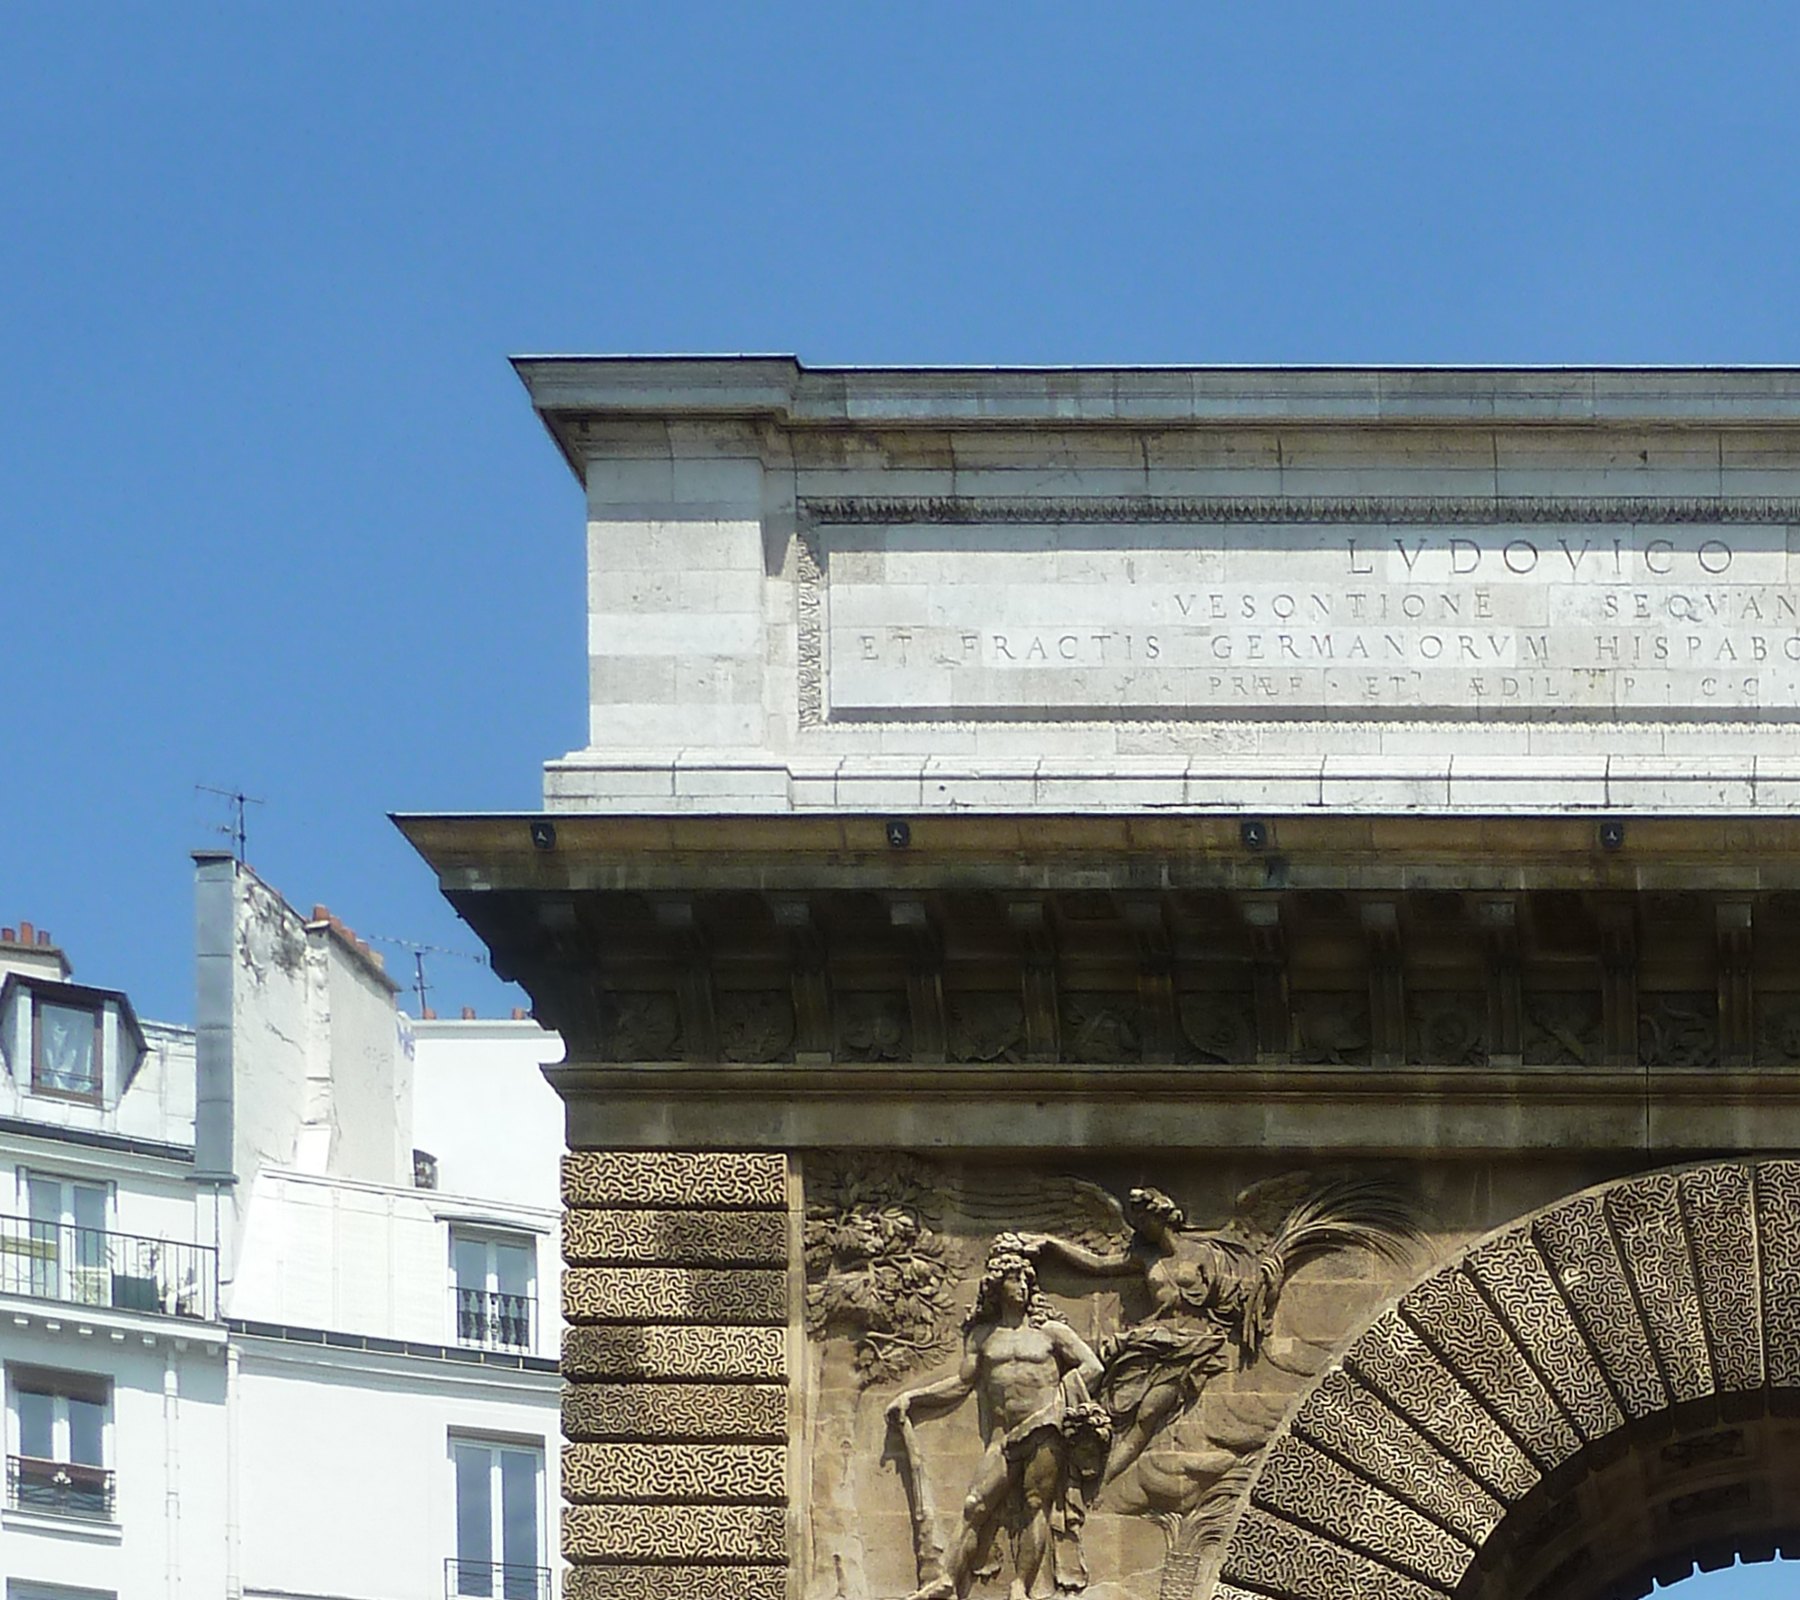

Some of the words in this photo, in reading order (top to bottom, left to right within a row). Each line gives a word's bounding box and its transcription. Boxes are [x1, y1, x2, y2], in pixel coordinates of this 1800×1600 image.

[1346, 538, 1732, 575] LVDOVICO
[1172, 593, 1493, 619] VESONTIONE
[860, 635, 912, 662] ET
[960, 634, 1161, 661] FRACTIS
[1211, 634, 1551, 661] GERMANORVM
